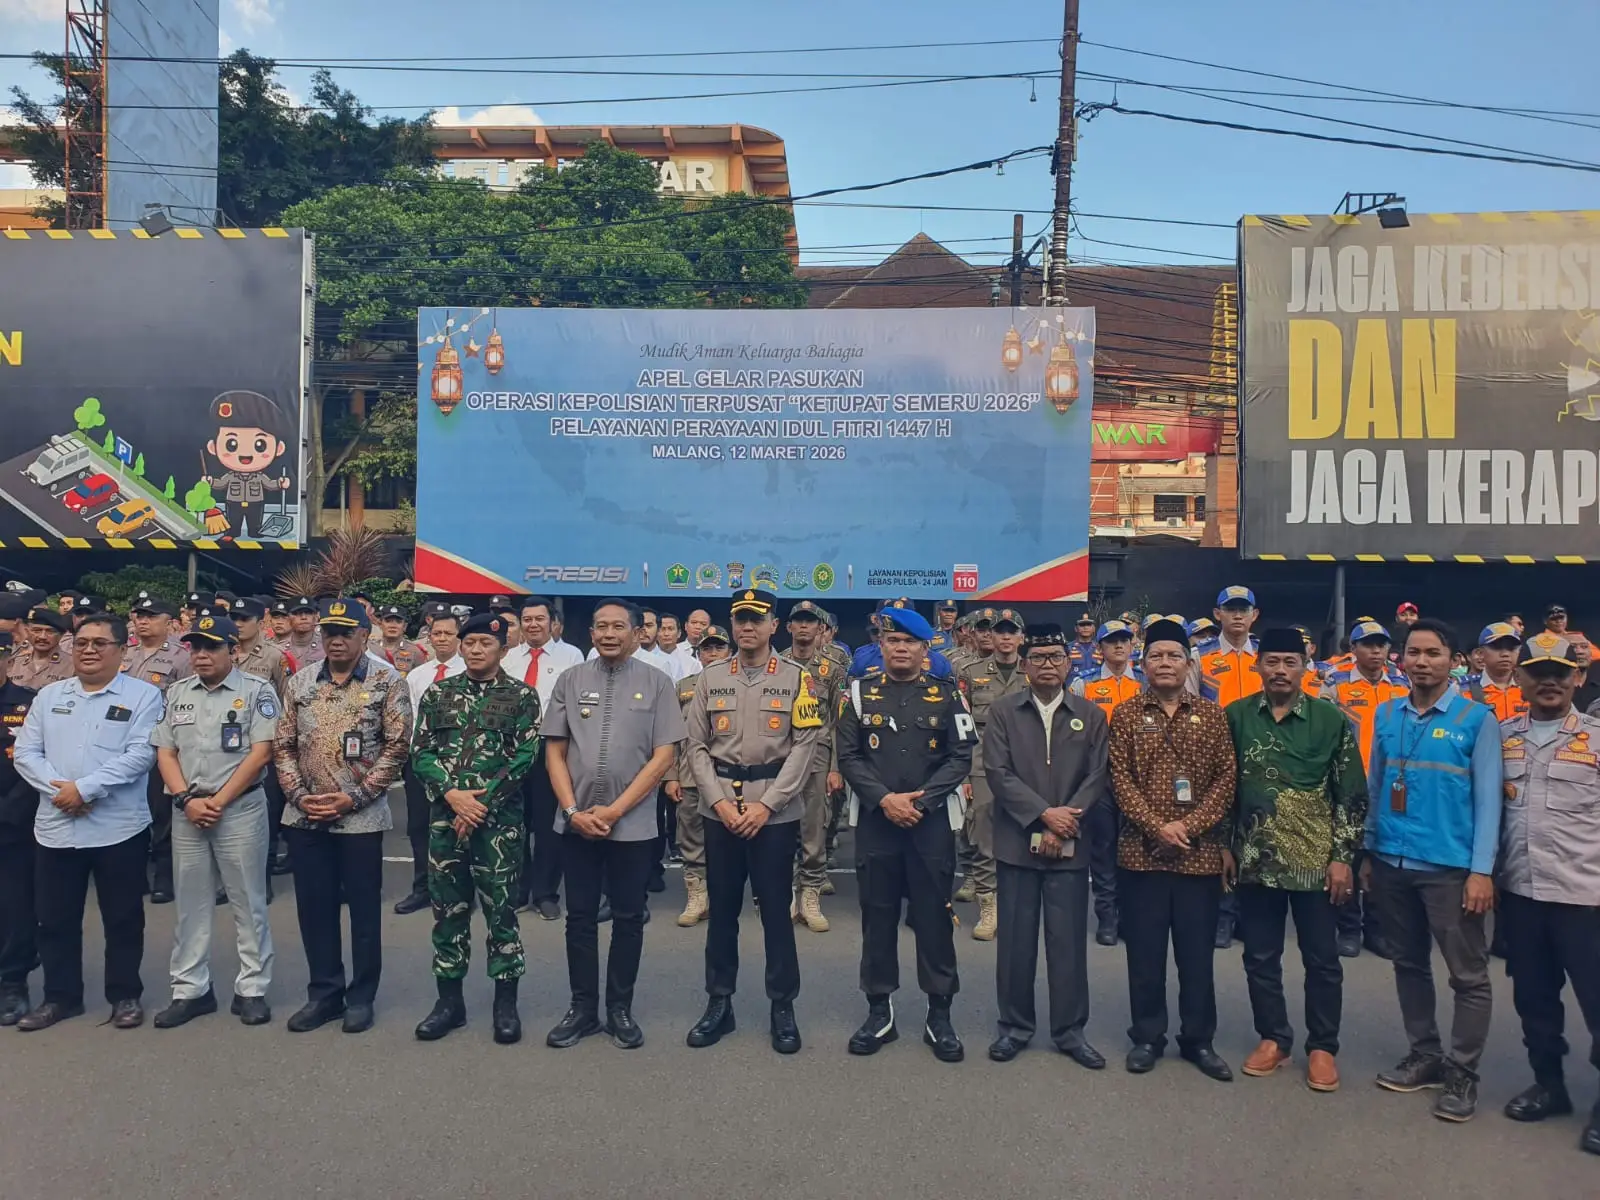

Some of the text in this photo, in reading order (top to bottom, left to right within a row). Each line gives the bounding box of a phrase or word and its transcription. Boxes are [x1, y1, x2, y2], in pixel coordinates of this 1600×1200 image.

[1287, 246, 1400, 312] JAGA
[640, 342, 864, 363] Mudik Aman Keluarga Bahagia
[637, 369, 864, 388] APEL GELAR PASUKAN
[1288, 319, 1456, 439] DAN
[466, 392, 554, 410] OPERASI
[558, 393, 676, 412] KEPOLISIAN
[681, 394, 784, 413] TERPUSAT
[894, 394, 980, 412] SEMERU
[550, 418, 951, 438] PELAYANAN PERAYAAN IDUL FITRI 1447 H
[1091, 423, 1168, 445] WAR
[652, 445, 846, 460] MALANG, 12 MARET 2026
[1286, 449, 1600, 524] JAGA KERAP
[524, 566, 630, 583] PRESISI
[867, 578, 892, 586] BEBAS
[893, 578, 918, 586] PULSA
[932, 578, 948, 586] JAM
[868, 569, 947, 577] LAYANAN KEPOLISIAN
[955, 577, 976, 588] 110
[710, 688, 736, 696] KHOLIS
[763, 688, 791, 696] POLRI
[174, 703, 194, 711] EKO
